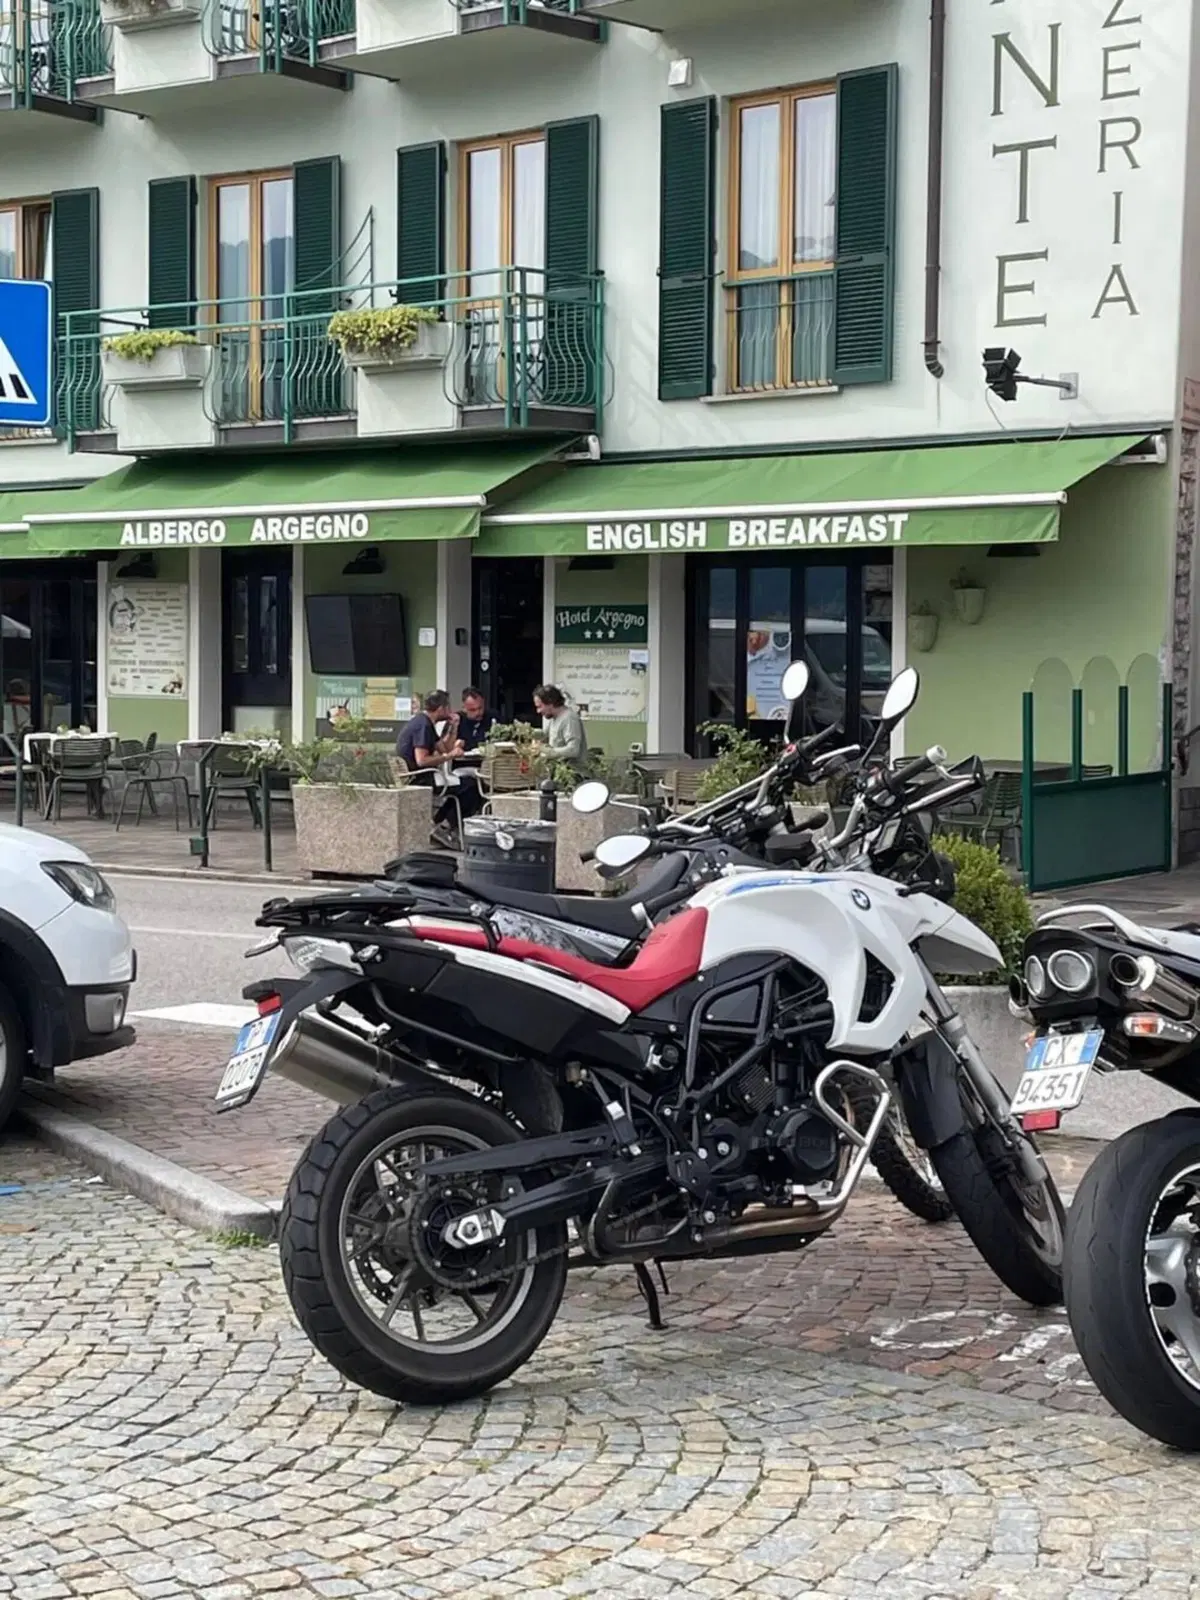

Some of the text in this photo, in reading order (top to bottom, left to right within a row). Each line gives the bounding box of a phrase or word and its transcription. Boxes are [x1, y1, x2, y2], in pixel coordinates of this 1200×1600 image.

[990, 0, 1062, 328] NTE
[120, 513, 369, 546] ALBERGO ARGEGNO
[586, 513, 908, 550] ENGLISH BREAKFAST
[556, 607, 645, 630] Hotel Argegno
[1042, 1036, 1073, 1067] CX
[1016, 1070, 1084, 1105] 94351
